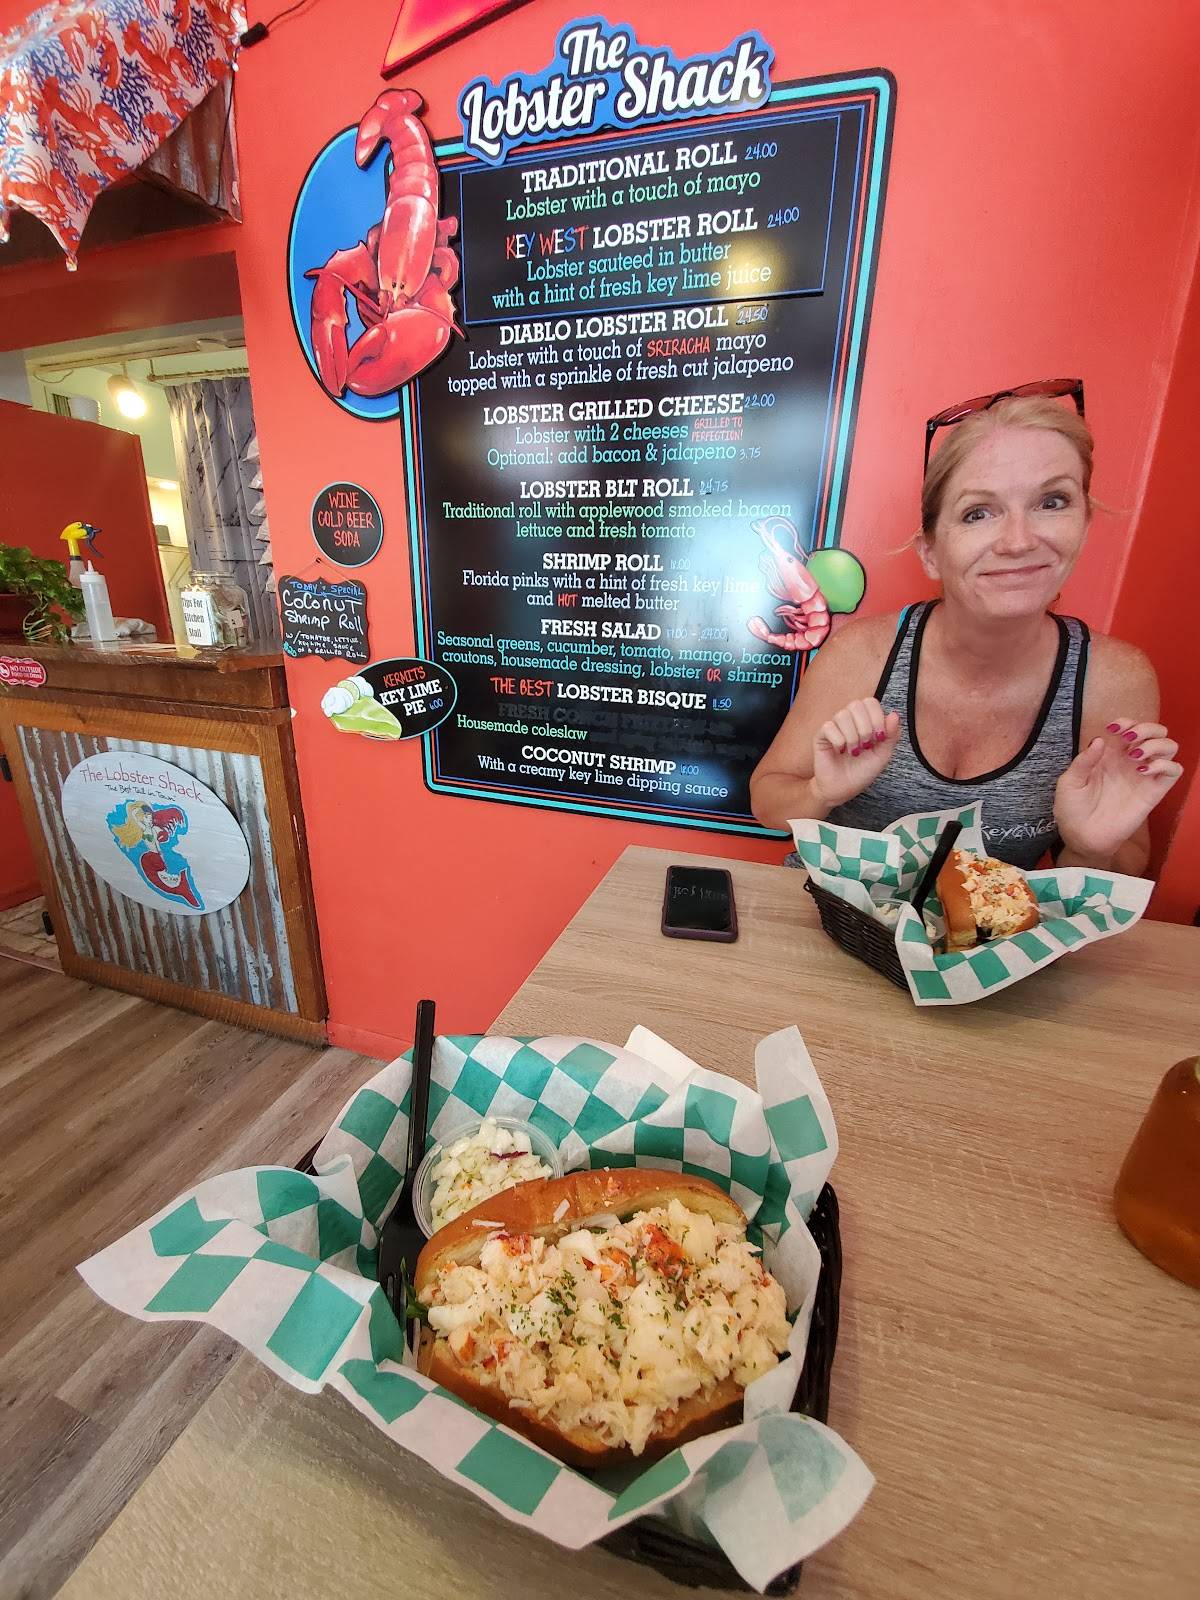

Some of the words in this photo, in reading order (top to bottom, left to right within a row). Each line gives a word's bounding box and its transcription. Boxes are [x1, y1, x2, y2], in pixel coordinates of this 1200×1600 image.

[563, 26, 627, 76] The
[463, 77, 606, 156] Lobster
[617, 41, 765, 119] Shack
[521, 152, 669, 192] TRADITIONAL
[675, 142, 737, 170] ROLL
[506, 197, 568, 220] Lobster
[571, 189, 607, 211] with
[612, 190, 624, 205] a
[628, 181, 678, 203] touch
[683, 177, 702, 195] of
[706, 172, 761, 194] mayo
[506, 232, 535, 259] KEY
[539, 226, 587, 254] WEST
[592, 216, 691, 248] LOBSTER
[696, 209, 758, 236] ROLL
[767, 206, 800, 228] 24.00
[526, 259, 584, 281] Lobster
[588, 249, 653, 274] sauteed
[658, 248, 674, 266] in
[678, 243, 729, 264] butter
[492, 289, 525, 308] with
[528, 290, 539, 305] a
[543, 284, 575, 303] hint
[578, 281, 595, 300] of
[599, 278, 642, 297] fresh
[646, 276, 678, 296] key
[681, 271, 722, 290] lime
[726, 263, 772, 290] juice
[499, 320, 571, 345] DIABLO
[575, 311, 667, 338] LOBSTER
[671, 305, 729, 329] ROLL
[469, 350, 523, 369] Lobster
[526, 345, 559, 365] with
[562, 348, 573, 362] a
[577, 341, 621, 361] touch
[625, 339, 642, 358] of
[646, 336, 710, 360] SRIRACHA
[715, 333, 766, 355] mayo
[447, 371, 497, 395] topped
[500, 369, 531, 388] with
[534, 373, 545, 386] a
[549, 365, 612, 389] sprinkle
[615, 363, 632, 381] of
[635, 360, 678, 380] fresh
[682, 358, 708, 377] cut
[712, 356, 793, 379] jalapeno
[483, 403, 564, 425] LOBSTER
[568, 398, 653, 421] GRILLED
[658, 393, 745, 417] CHEESE
[694, 418, 730, 429] GRILLED
[732, 416, 743, 427] TO
[514, 426, 570, 444] Lobster
[573, 425, 605, 442] with
[609, 424, 619, 441] 2
[623, 424, 688, 440] cheeses
[691, 429, 744, 441] PERFECTION!
[487, 447, 553, 469] Optional:
[557, 445, 588, 463] add
[591, 445, 641, 463] bacon
[645, 443, 658, 461] &
[661, 443, 736, 465] jalapeno
[328, 491, 361, 509] WINE
[520, 480, 601, 498] LOBSTER
[605, 479, 638, 497] BLT
[641, 478, 694, 497] ROLL
[317, 510, 344, 528] COLD
[346, 511, 375, 529] BEER
[442, 501, 515, 518] Traditional
[518, 501, 541, 518] roll
[544, 501, 575, 518] with
[578, 501, 664, 522] applewood
[668, 500, 732, 518] smoked
[736, 499, 792, 517] bacon
[333, 530, 361, 547] SODA
[516, 521, 562, 537] lettuce
[566, 521, 595, 537] and
[598, 521, 637, 538] fresh
[640, 523, 696, 538] tomato
[542, 553, 611, 570] SHRIMP
[614, 554, 664, 571] ROLL
[462, 569, 509, 586] Florida
[512, 571, 549, 590] pinks
[552, 572, 582, 589] with
[585, 578, 596, 589] a
[599, 573, 628, 590] hint
[631, 574, 646, 590] of
[649, 574, 688, 592] fresh
[693, 575, 720, 596] key
[526, 591, 553, 606] and
[557, 593, 578, 607] HOT
[581, 592, 631, 609] melted
[634, 594, 680, 610] butter
[540, 619, 597, 637] FRESH
[601, 621, 661, 640] SALAD
[437, 631, 494, 649] Seasonal
[497, 638, 542, 656] greens,
[547, 640, 616, 658] cucumber,
[620, 643, 674, 661] tomato,
[679, 648, 736, 666] mango,
[741, 647, 791, 666] bacon
[383, 666, 426, 688] KERMITS
[442, 651, 497, 666] croutons,
[501, 653, 577, 670] housemade
[580, 657, 645, 678] dressing,
[649, 661, 702, 678] lobster
[706, 664, 721, 681] OR
[726, 665, 783, 686] shrimp
[379, 687, 406, 706] KEY
[407, 679, 443, 700] LIME
[490, 677, 515, 694] THE
[519, 678, 554, 697] BEST
[556, 683, 633, 703] LOBSTER
[636, 689, 707, 709] BISQUE
[403, 699, 427, 717] PIE
[457, 714, 529, 734] Housemade
[531, 723, 588, 740] coleslaw
[521, 746, 606, 767] COCONUT
[609, 756, 677, 775] SHRIMP
[80, 763, 103, 783] The
[105, 762, 155, 786] Lobster
[159, 771, 204, 804] Shack
[478, 755, 505, 771] With
[507, 762, 516, 772] a
[519, 764, 566, 780] creamy
[568, 765, 592, 784] key
[594, 769, 623, 785] lime
[626, 773, 681, 794] dipping
[684, 784, 728, 797] sauce
